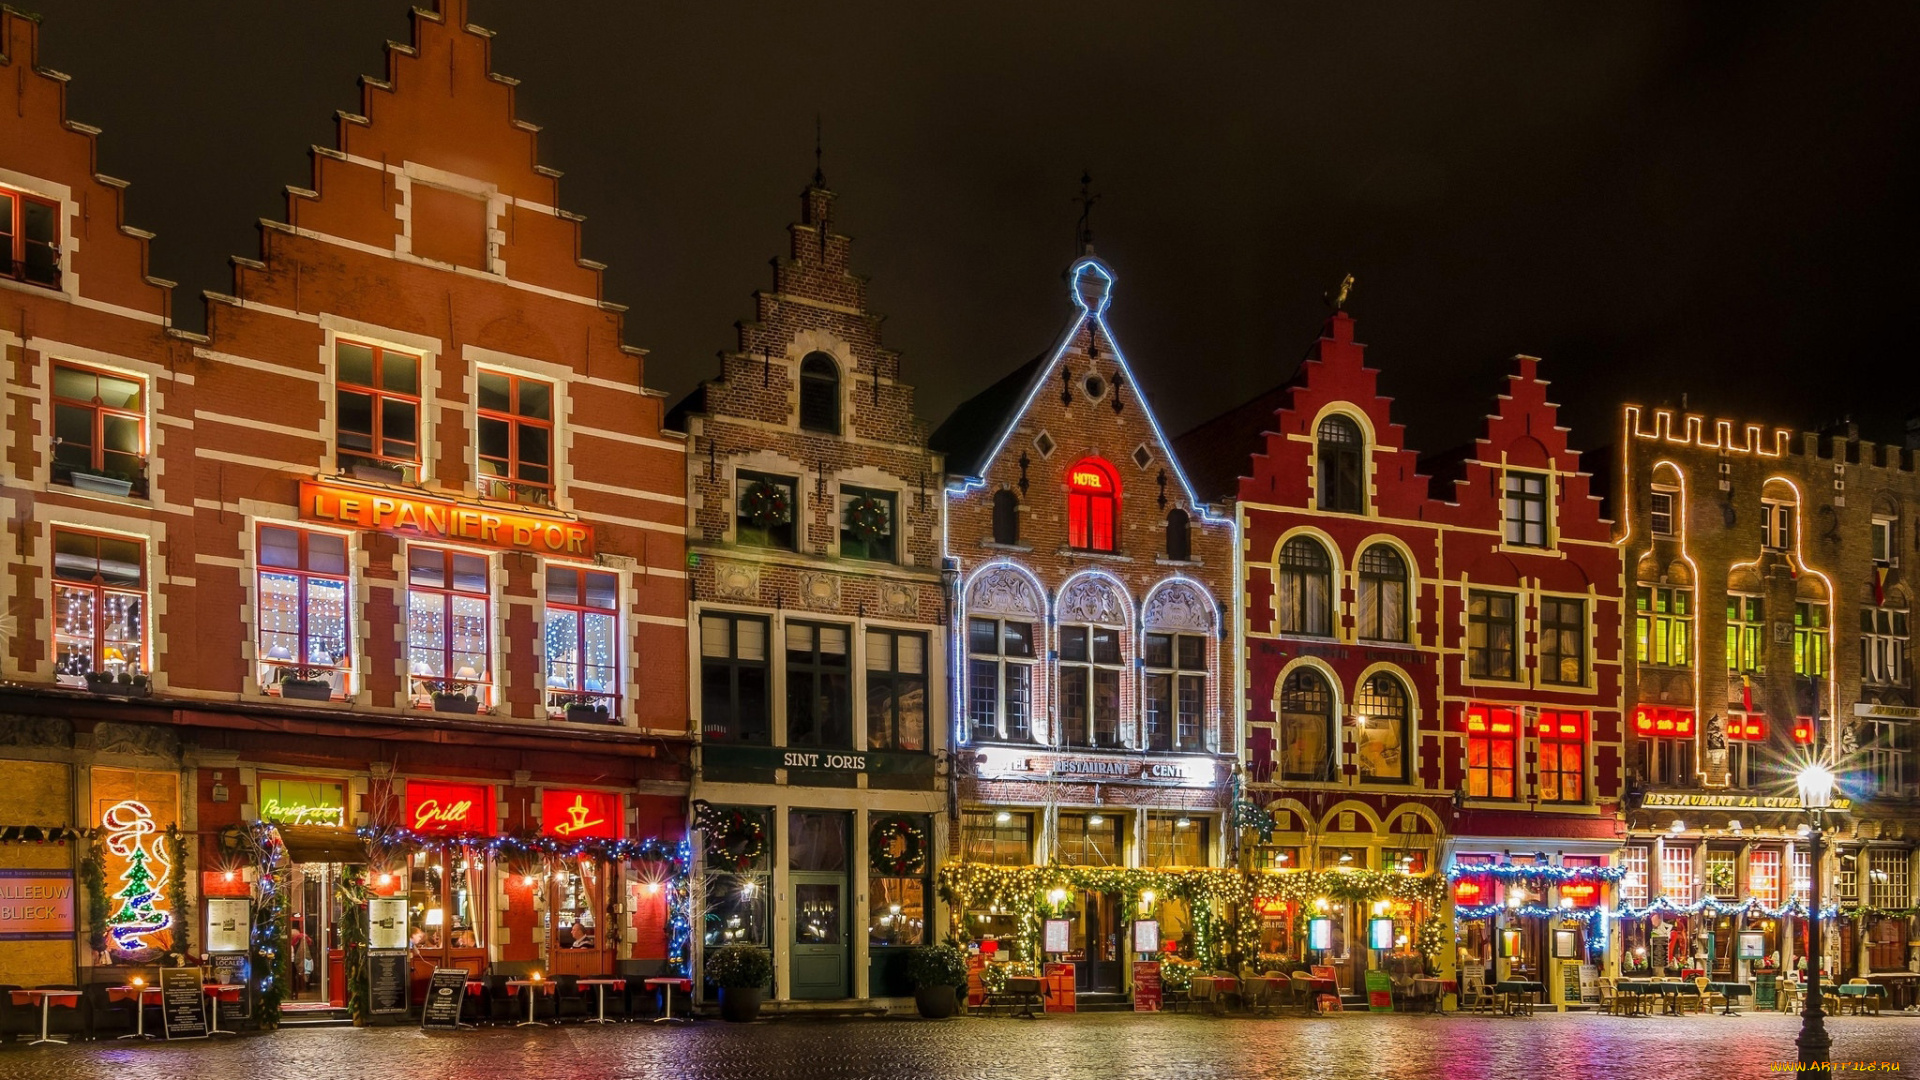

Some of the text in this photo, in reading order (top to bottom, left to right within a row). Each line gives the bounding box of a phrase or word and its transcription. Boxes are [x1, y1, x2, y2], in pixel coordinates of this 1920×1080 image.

[1073, 472, 1102, 487] HOTEL
[315, 495, 587, 553] LE PANIER D'OR
[784, 753, 866, 769] SINT JORIS
[1054, 760, 1130, 775] RESTAURANT
[1646, 794, 1735, 806] RESTAURANT
[1739, 796, 1758, 807] LA
[414, 799, 472, 829] Grill
[2, 906, 56, 920] BLIECK
